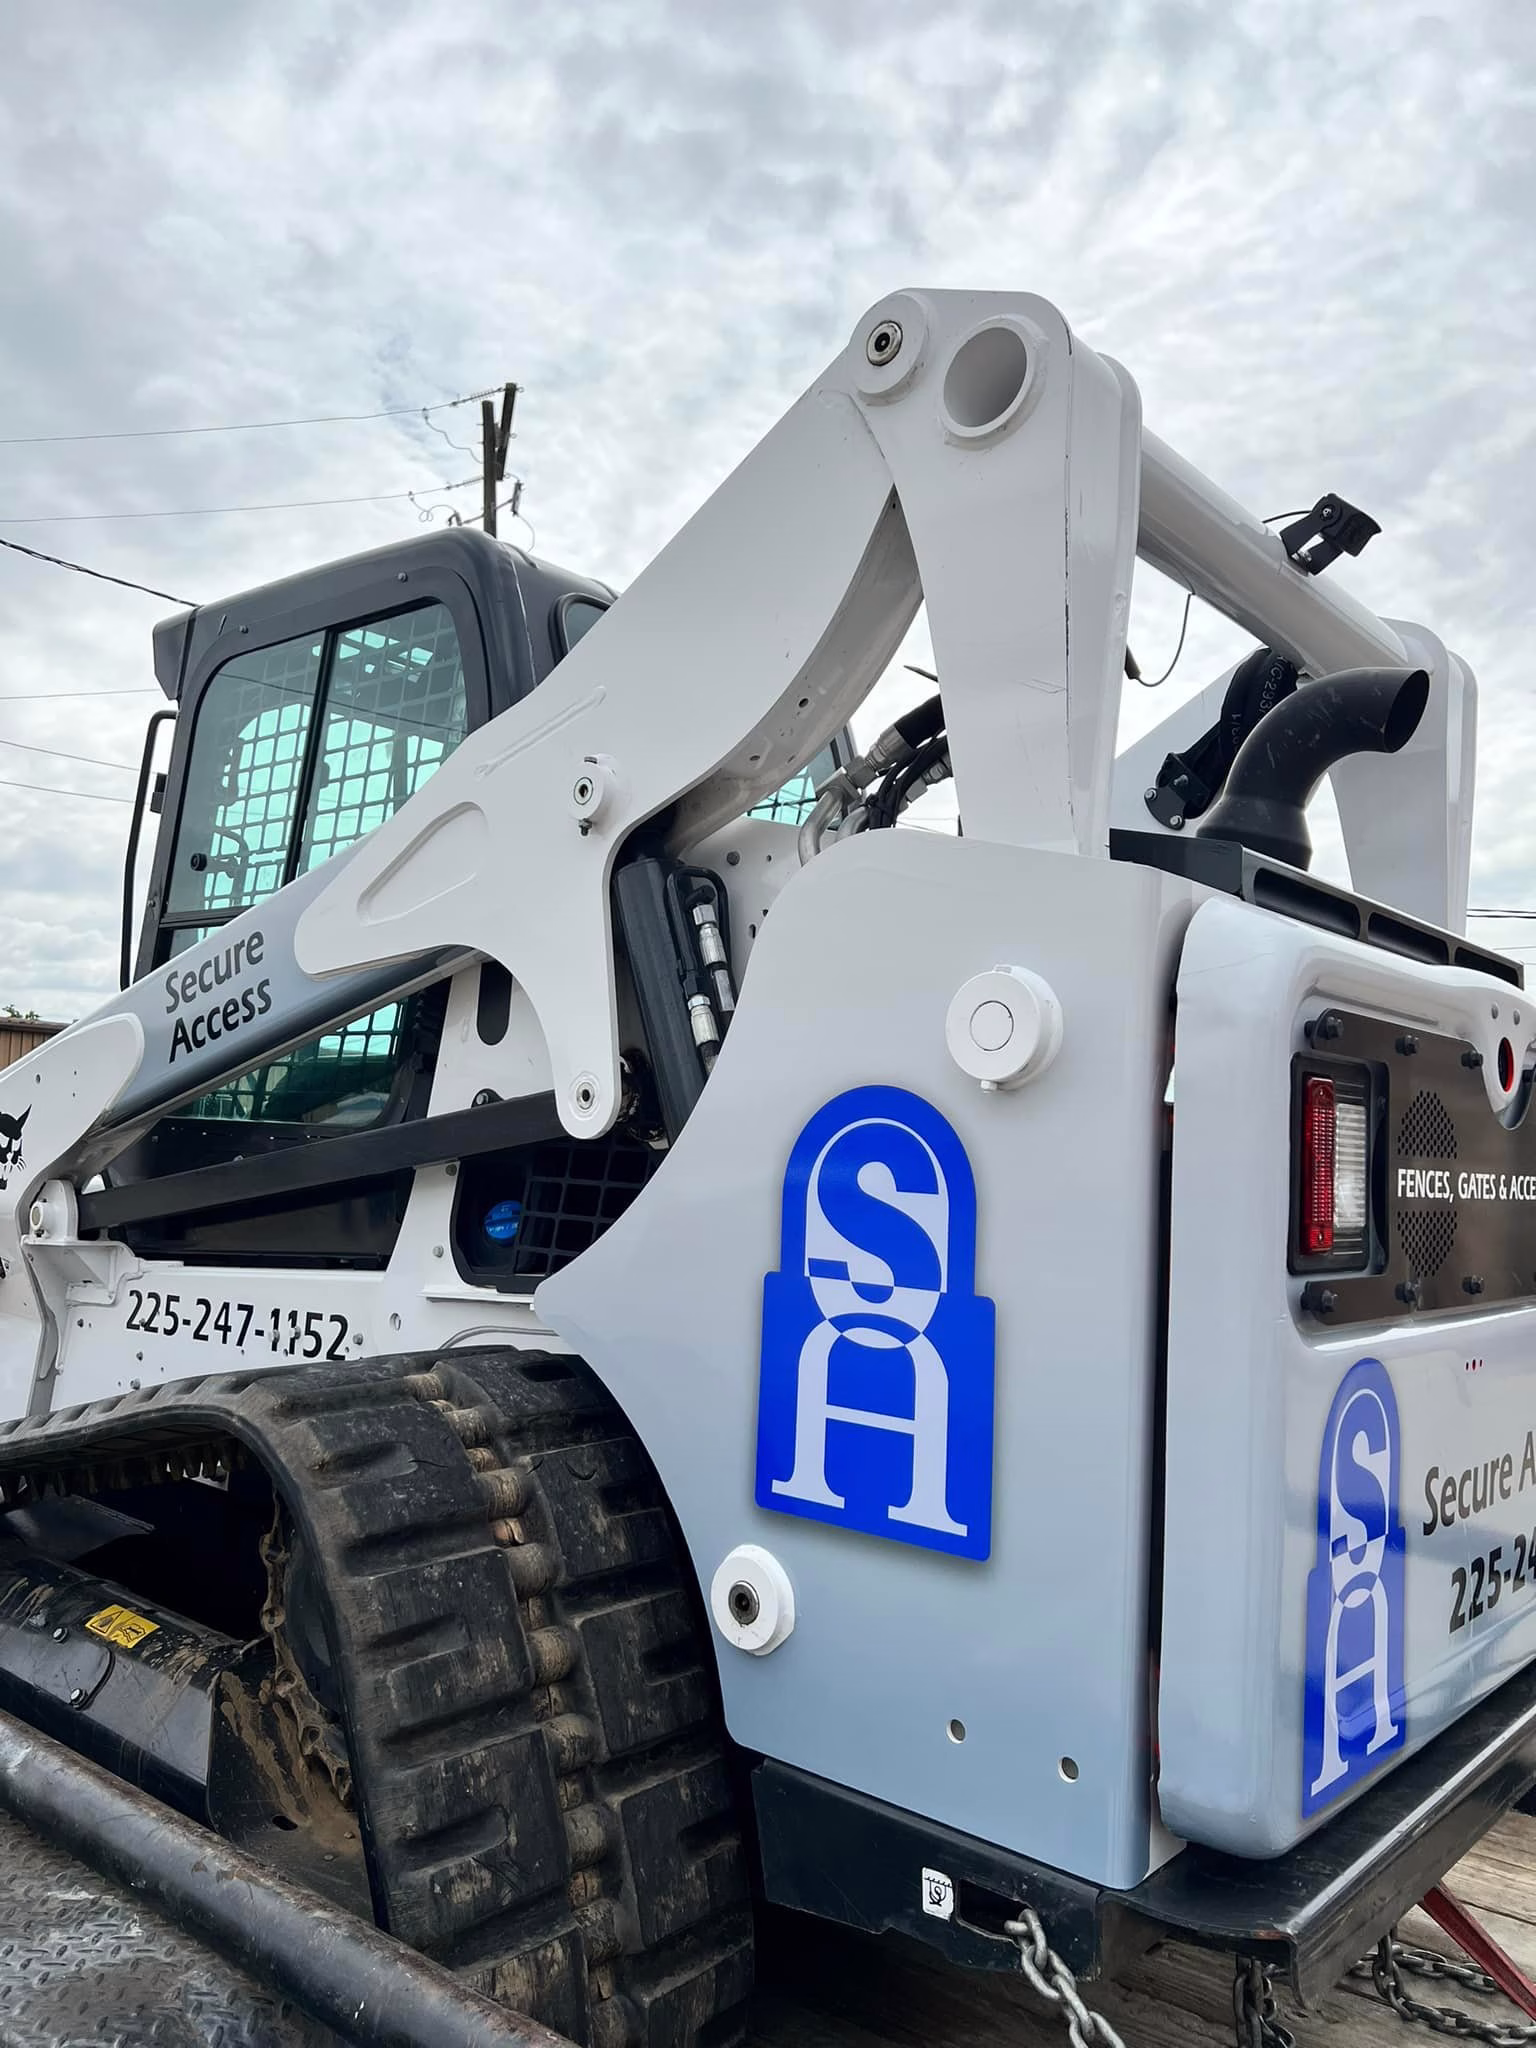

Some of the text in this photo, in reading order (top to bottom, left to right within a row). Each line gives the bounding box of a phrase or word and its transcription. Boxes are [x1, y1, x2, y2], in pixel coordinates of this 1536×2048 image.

[165, 931, 265, 1014] Secure
[169, 978, 272, 1065] Access
[1397, 1167, 1454, 1204] FENCES,
[1458, 1172, 1496, 1200] GATES
[1499, 1175, 1508, 1200] &
[126, 1289, 349, 1361] 225-247-1152
[1423, 1453, 1513, 1537] Secure
